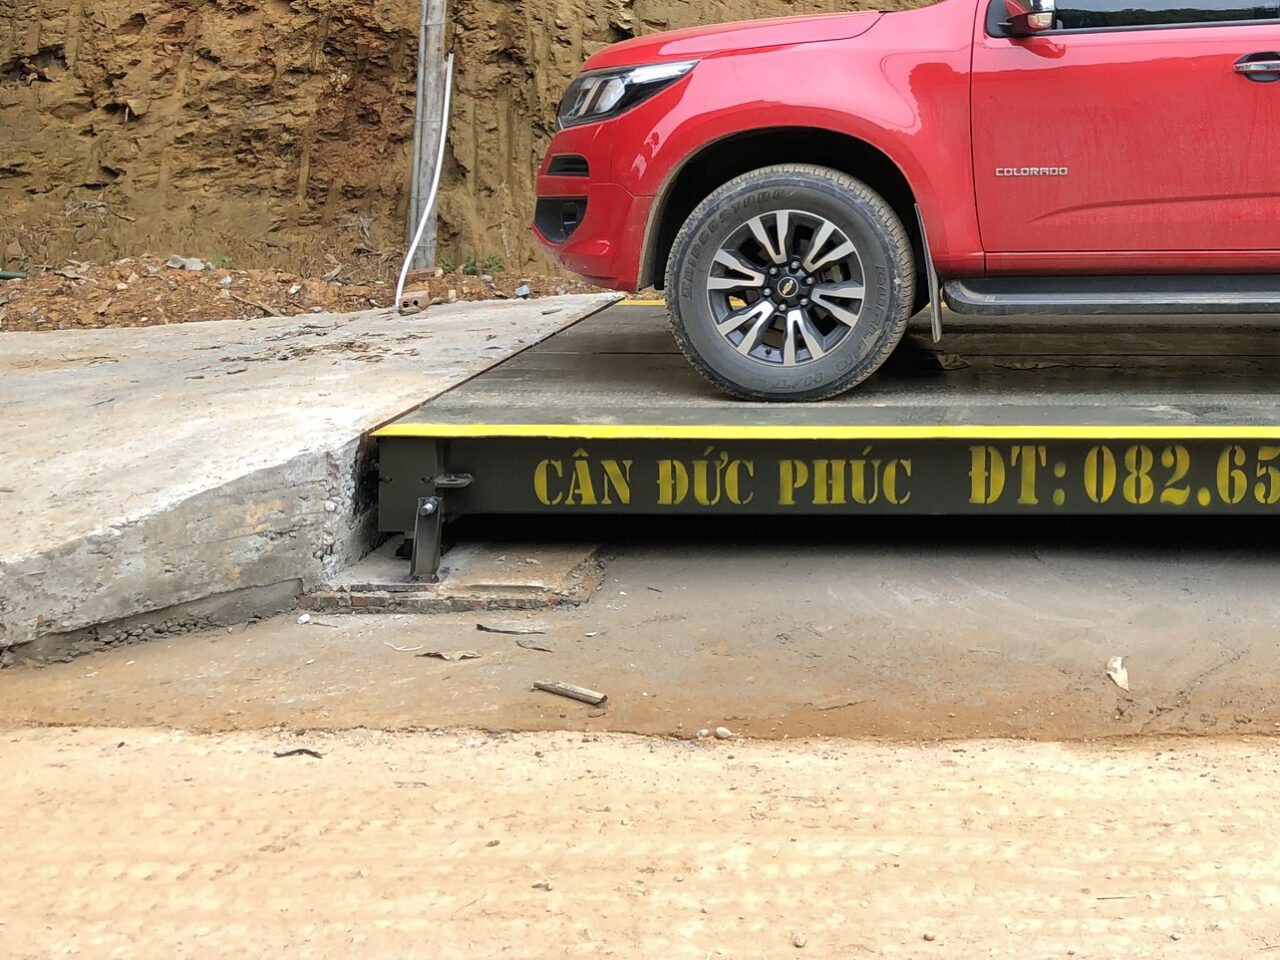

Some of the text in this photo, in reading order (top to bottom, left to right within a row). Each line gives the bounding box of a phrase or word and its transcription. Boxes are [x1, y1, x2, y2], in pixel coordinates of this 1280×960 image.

[995, 167, 1068, 176] COLORADO
[533, 447, 633, 505] CÂN
[656, 445, 755, 506] ĐỨC
[777, 444, 912, 506] PHÚC
[969, 445, 1066, 506] ĐT:
